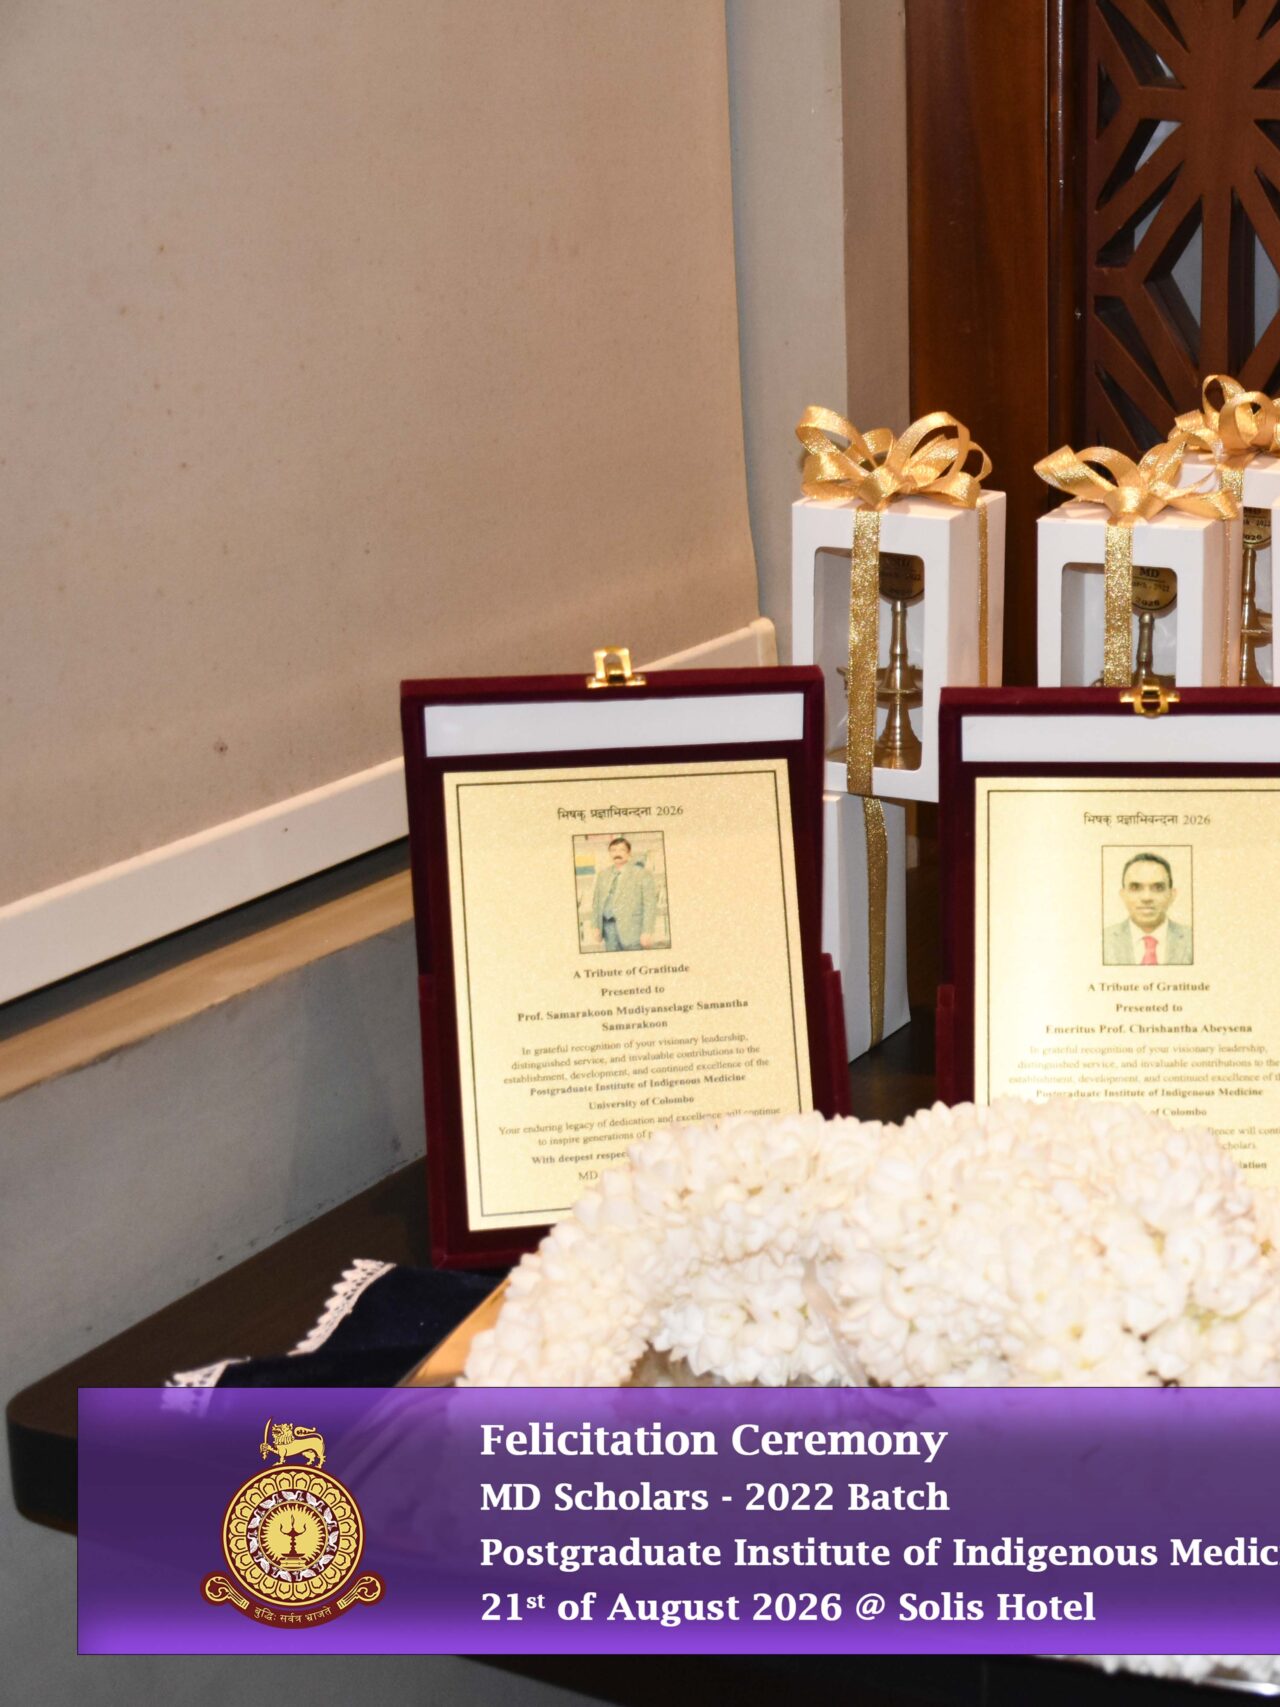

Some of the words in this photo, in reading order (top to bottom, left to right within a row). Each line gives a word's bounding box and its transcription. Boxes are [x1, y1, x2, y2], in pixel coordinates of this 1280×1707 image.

[1140, 566, 1159, 577] MD
[656, 806, 684, 816] 2026
[1184, 816, 1211, 825] 2026
[574, 971, 581, 979] A
[584, 968, 622, 978] Tribute
[626, 967, 636, 976] of
[638, 964, 690, 975] Gratitude
[601, 986, 652, 996] Presented
[654, 986, 665, 994] to
[1089, 984, 1095, 992] A
[1101, 983, 1139, 991] Tribute
[1143, 983, 1154, 991] of
[1156, 983, 1210, 991] Gratitude
[518, 1012, 544, 1022] Prof.
[546, 1008, 613, 1020] Samarakoon
[616, 1003, 694, 1017] Mudiyanselage
[696, 999, 748, 1010] Samantha
[1116, 1004, 1168, 1012] Presented
[1172, 1004, 1183, 1012] to
[602, 1020, 668, 1031] Samarakoon
[1129, 1025, 1198, 1033] Chrishantha
[1202, 1025, 1252, 1036] Abeysena
[522, 1047, 531, 1056] In
[534, 1045, 568, 1056] grateful
[571, 1043, 621, 1054] recognition
[624, 1040, 634, 1048] of
[635, 1041, 655, 1050] your
[658, 1037, 699, 1048] visionary
[530, 1084, 593, 1097] Postgraduate
[595, 1081, 635, 1092] Institute
[638, 1080, 647, 1088] of
[650, 1076, 701, 1089] Indigenous
[704, 1073, 746, 1083] Medicine
[589, 1100, 637, 1112] University
[640, 1098, 650, 1106] of
[652, 1095, 694, 1105] Colombo
[1162, 1108, 1207, 1116] Colombo
[499, 1126, 520, 1135] Your
[523, 1123, 563, 1136] enduring
[565, 1121, 594, 1132] legacy
[597, 1120, 607, 1128] of
[609, 1116, 655, 1127] dedication
[657, 1114, 674, 1124] and
[1239, 1126, 1256, 1135] will
[538, 1138, 547, 1146] to
[549, 1134, 580, 1146] inspire
[582, 1133, 634, 1144] generations
[636, 1130, 646, 1140] of
[532, 1155, 555, 1164] With
[558, 1154, 593, 1164] deepest
[596, 1152, 629, 1161] respec
[578, 1171, 598, 1181] MD
